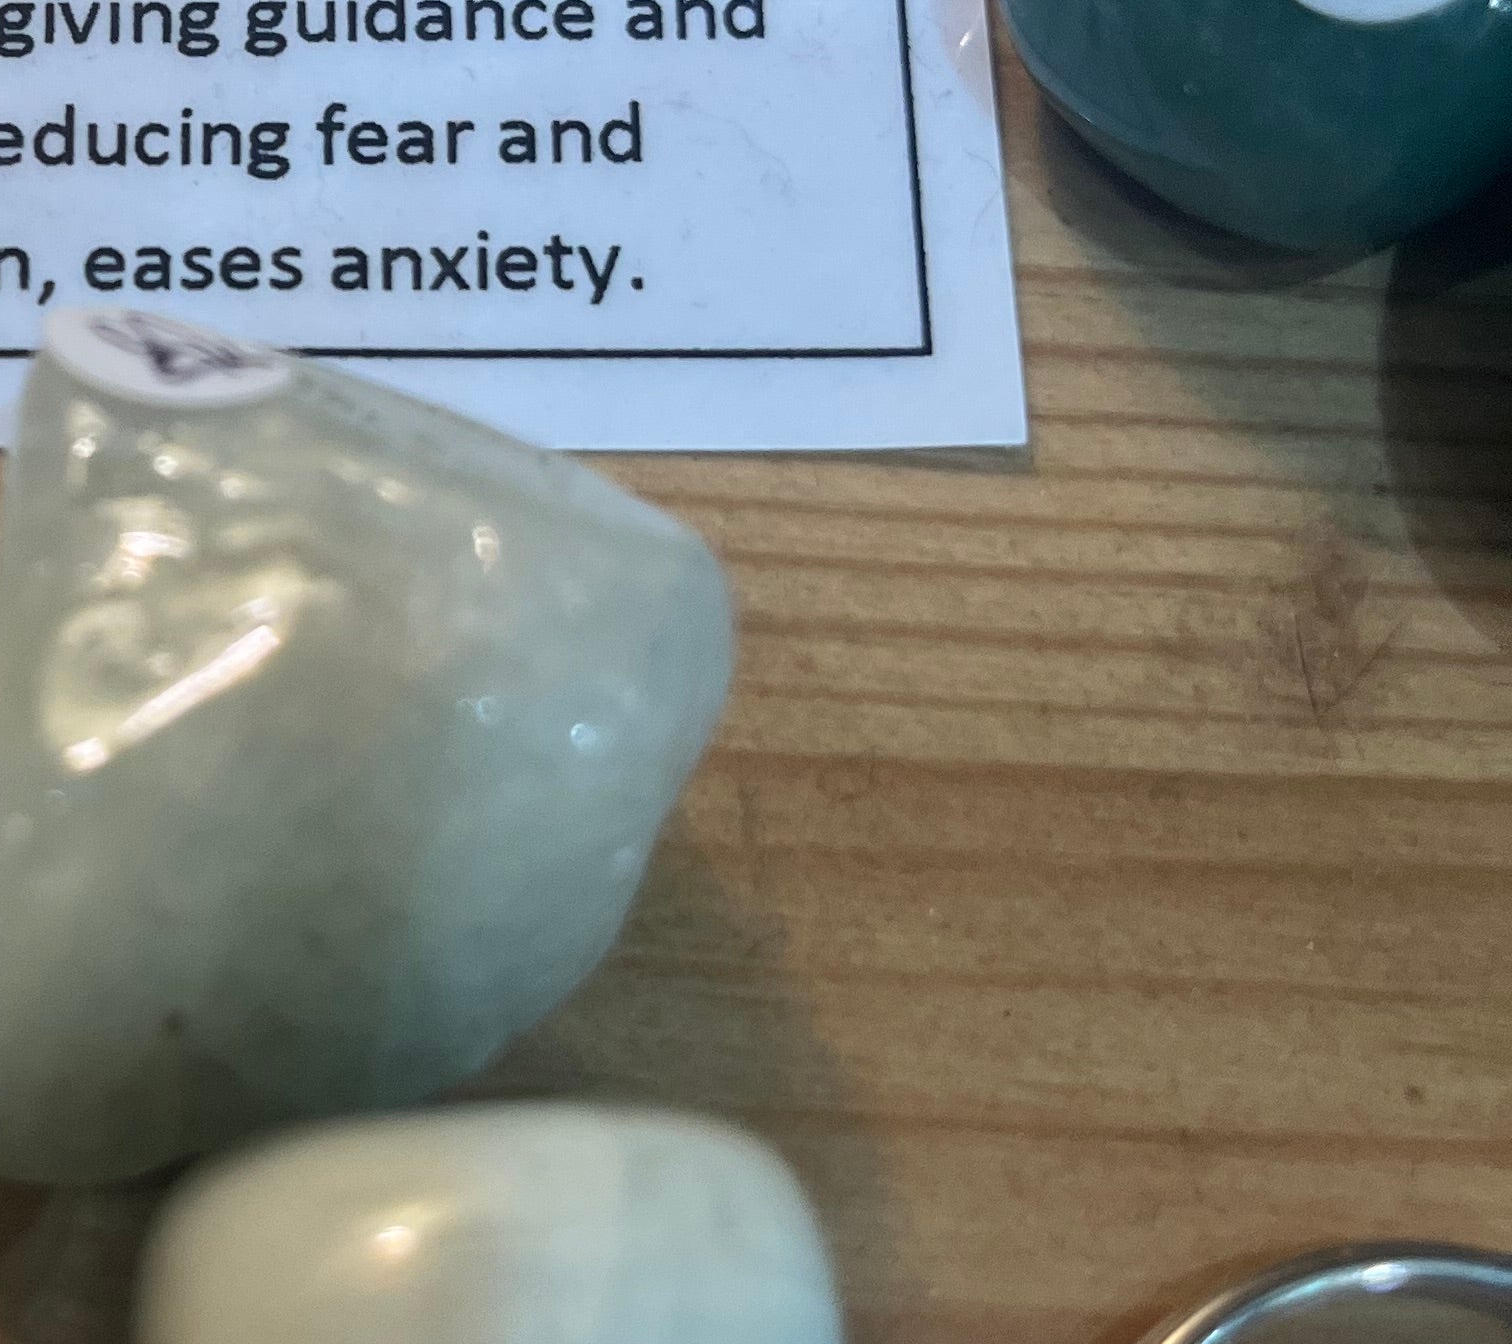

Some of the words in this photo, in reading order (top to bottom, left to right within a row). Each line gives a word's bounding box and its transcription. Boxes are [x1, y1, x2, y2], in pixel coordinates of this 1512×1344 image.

[313, 101, 476, 168] fear
[496, 98, 644, 166] and
[81, 245, 305, 294] eases
[329, 229, 645, 307] anxiety.
